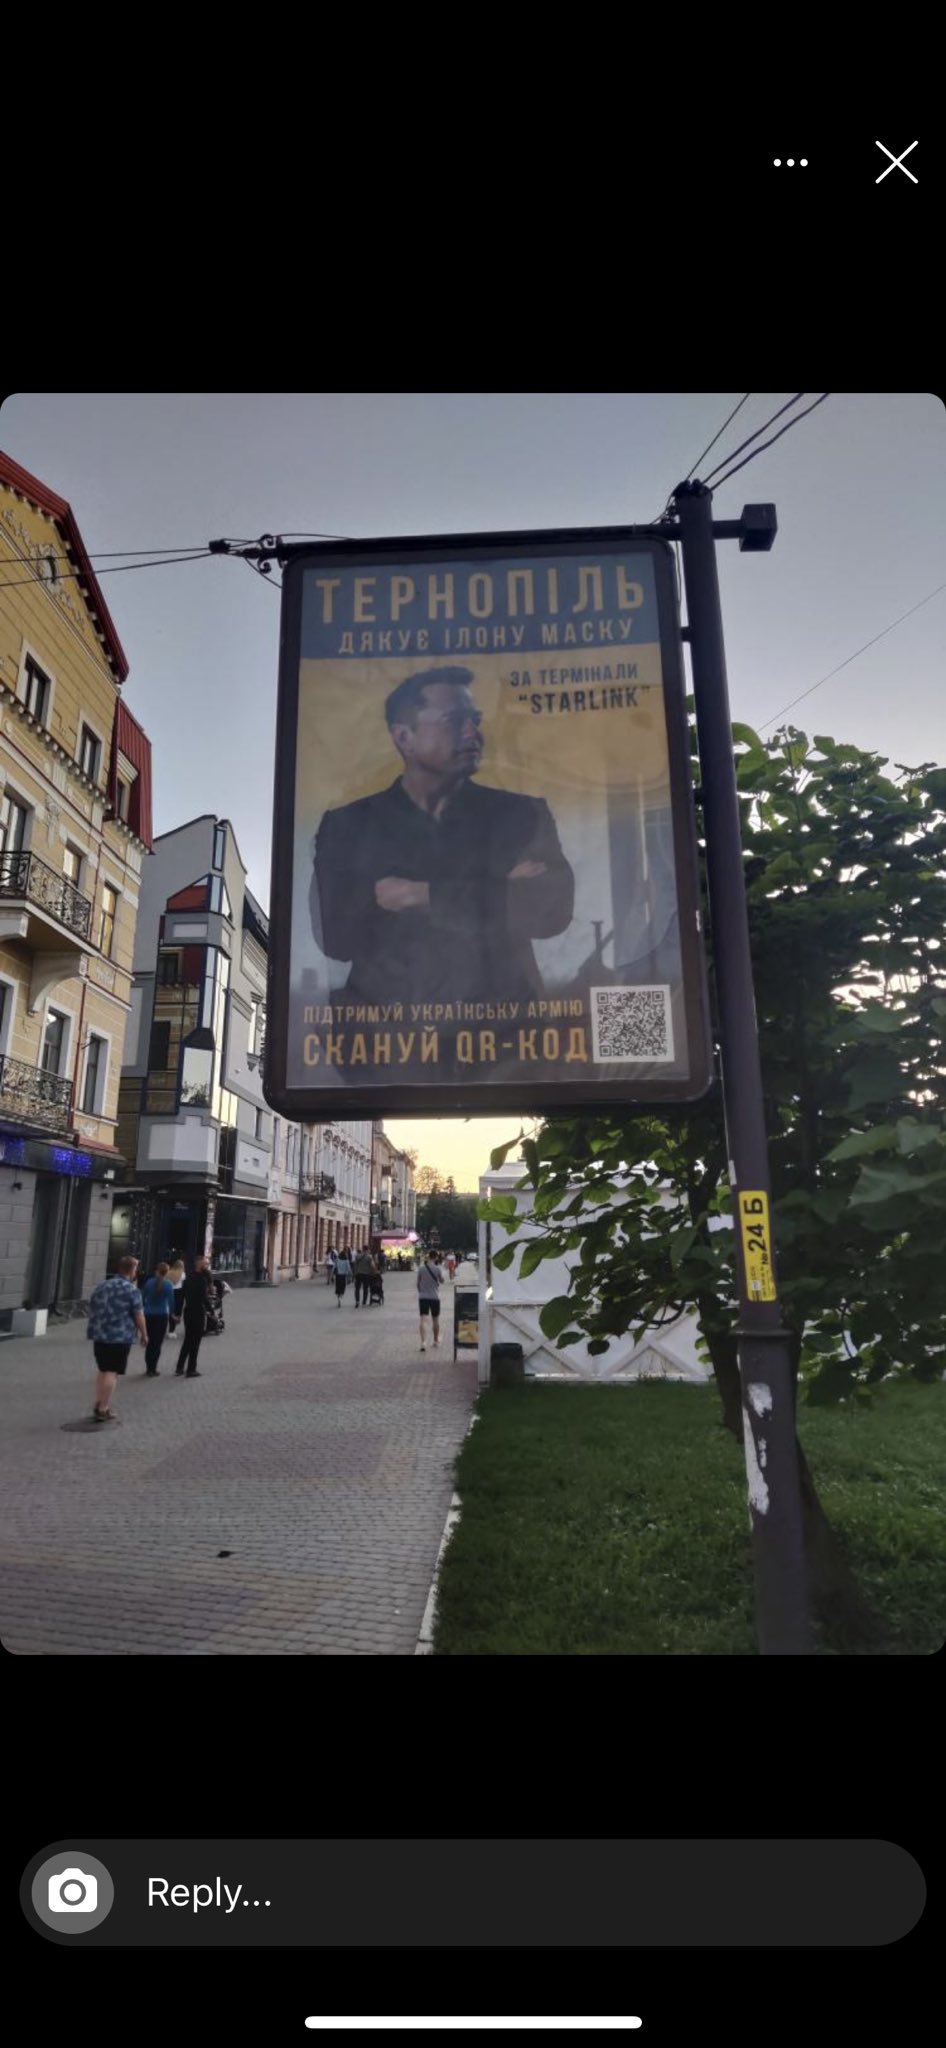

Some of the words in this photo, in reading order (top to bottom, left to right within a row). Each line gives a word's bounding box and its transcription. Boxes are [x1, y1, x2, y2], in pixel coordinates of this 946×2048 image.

[315, 565, 644, 624] ТЕРНОПІЛЬ
[338, 629, 430, 655] ДЯКУЄ
[444, 624, 525, 650] ІЛОНУ
[541, 617, 633, 645] МАСКУ
[510, 669, 532, 687] ЗА
[538, 663, 638, 686] ТЕРМІНАЛИ
[303, 1002, 404, 1025] ПІДТРИМУЙ
[410, 1000, 519, 1022] УКРАЇНСЬКУ
[527, 999, 583, 1018] АРМІЮ
[303, 1025, 440, 1067] СКАНУЙ
[456, 1027, 589, 1064] QR-КОД
[743, 1198, 764, 1215] Б
[746, 1223, 767, 1252] 24
